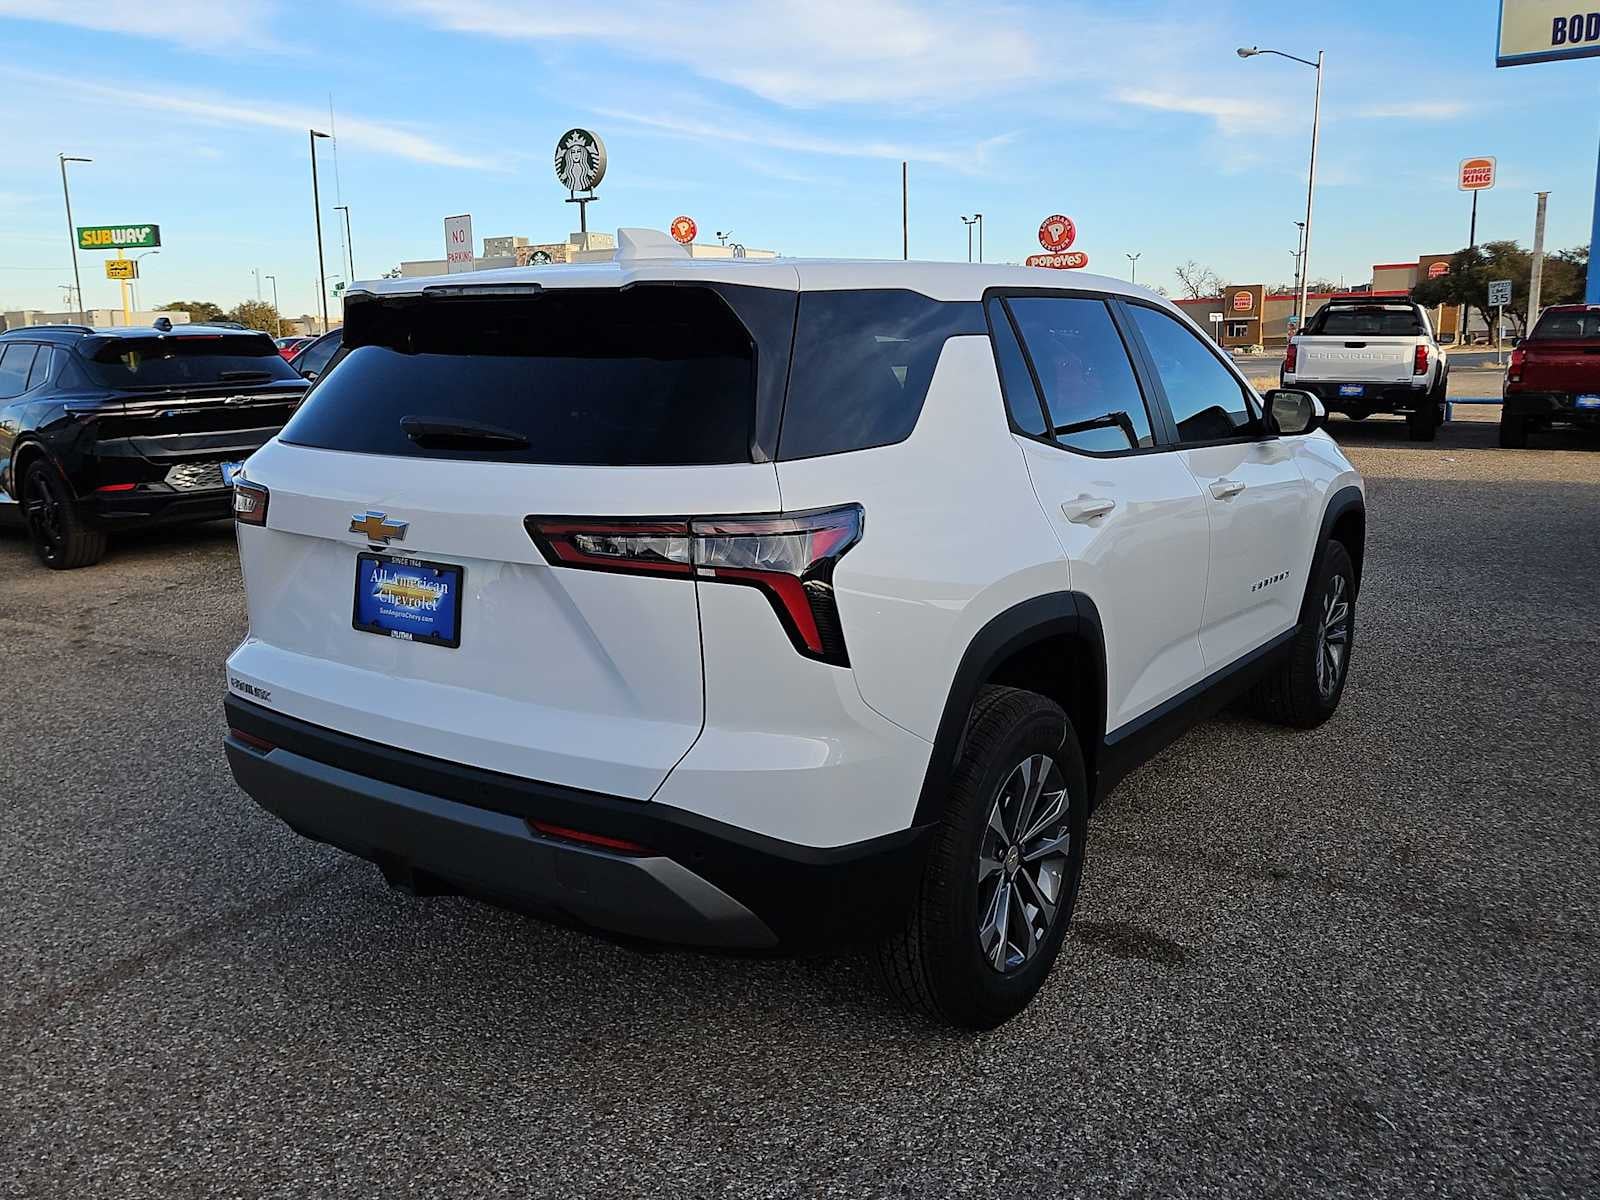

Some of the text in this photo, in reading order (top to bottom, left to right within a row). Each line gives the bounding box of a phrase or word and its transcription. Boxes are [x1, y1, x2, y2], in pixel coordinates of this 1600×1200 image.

[1552, 13, 1600, 46] BOD
[1463, 167, 1491, 175] BURGER
[1463, 174, 1491, 183] KING
[80, 227, 151, 246] SUBWAY
[452, 229, 465, 244] NO
[1047, 223, 1065, 243] P
[448, 250, 472, 264] PARKING
[1491, 294, 1509, 304] 35
[1307, 352, 1401, 361] CHEVROLET
[391, 557, 409, 566] SINCE
[370, 569, 448, 594] All American
[379, 588, 437, 611] Chevrolet
